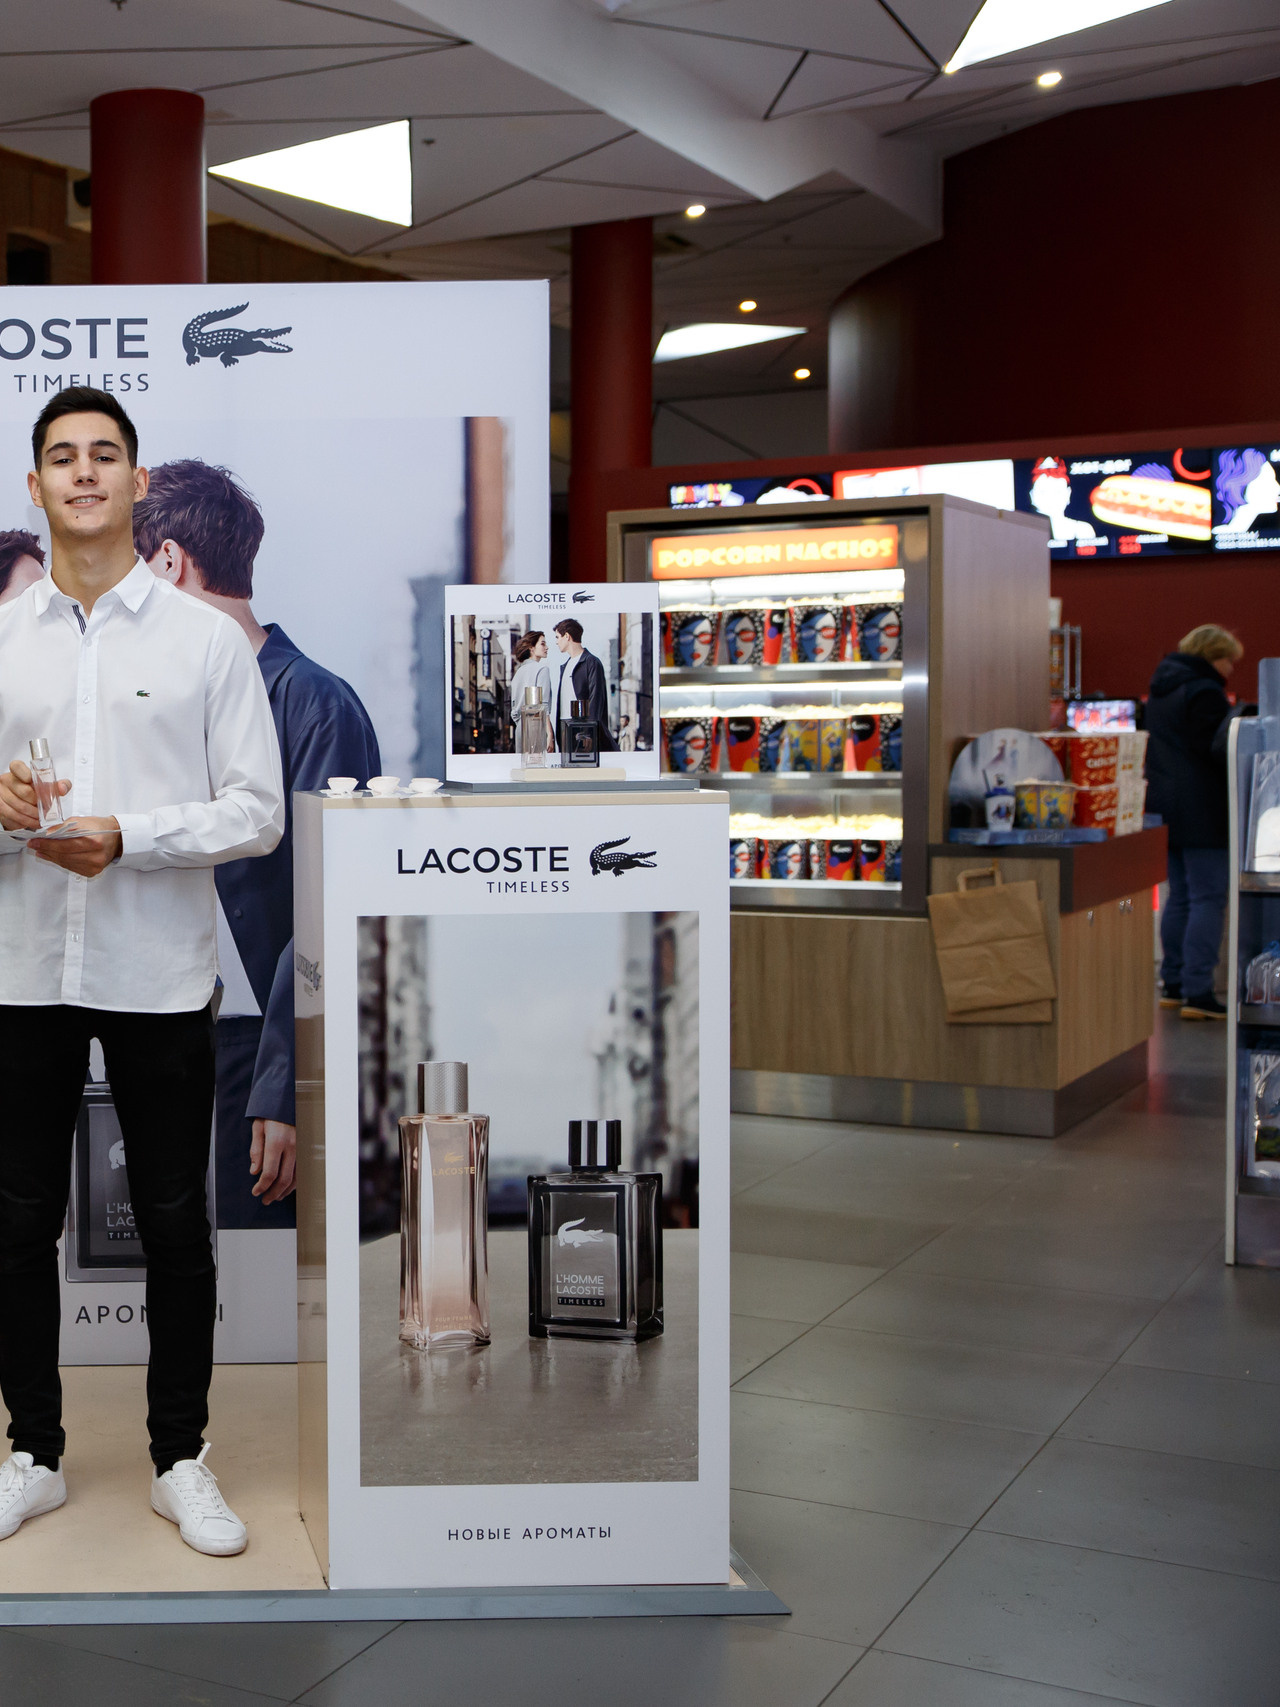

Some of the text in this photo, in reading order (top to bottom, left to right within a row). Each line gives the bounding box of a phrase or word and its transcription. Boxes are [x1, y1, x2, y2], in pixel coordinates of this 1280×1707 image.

[13, 373, 150, 393] TIMELESS
[658, 537, 894, 569] POPCORN NACHOS
[508, 593, 566, 603] LACOSTE
[397, 846, 570, 875] LACOSTE
[486, 880, 570, 893] TIMELESS
[432, 1166, 476, 1176] LACOSTE
[556, 1273, 605, 1285] L'HOMME
[556, 1285, 605, 1296] LACOSTE
[558, 1298, 604, 1306] TIMELESS
[448, 1526, 612, 1541] НОВЫЕ АРОМАТЫ
